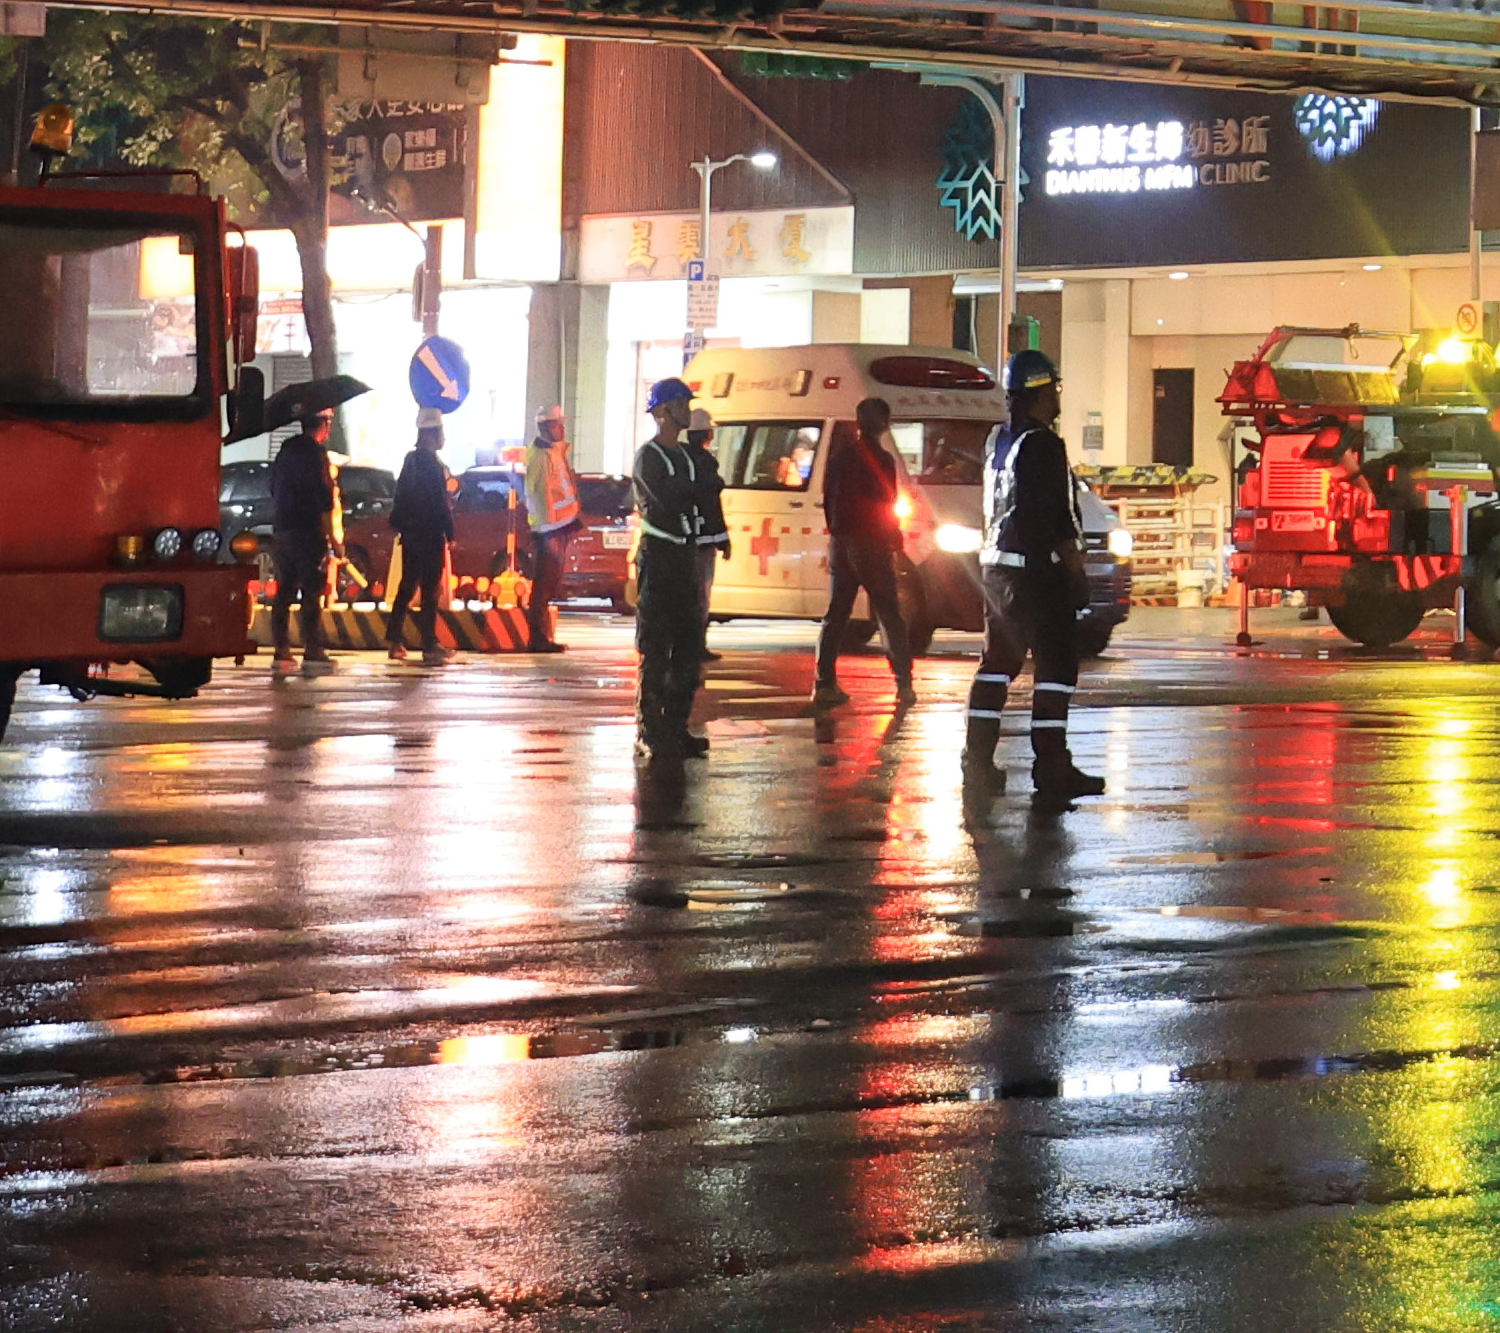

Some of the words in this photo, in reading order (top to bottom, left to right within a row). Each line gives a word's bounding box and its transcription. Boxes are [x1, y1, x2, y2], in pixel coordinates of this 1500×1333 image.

[1045, 166, 1141, 196] DIANTHUS
[1144, 164, 1193, 190] MFM
[1199, 160, 1271, 186] CLINIC
